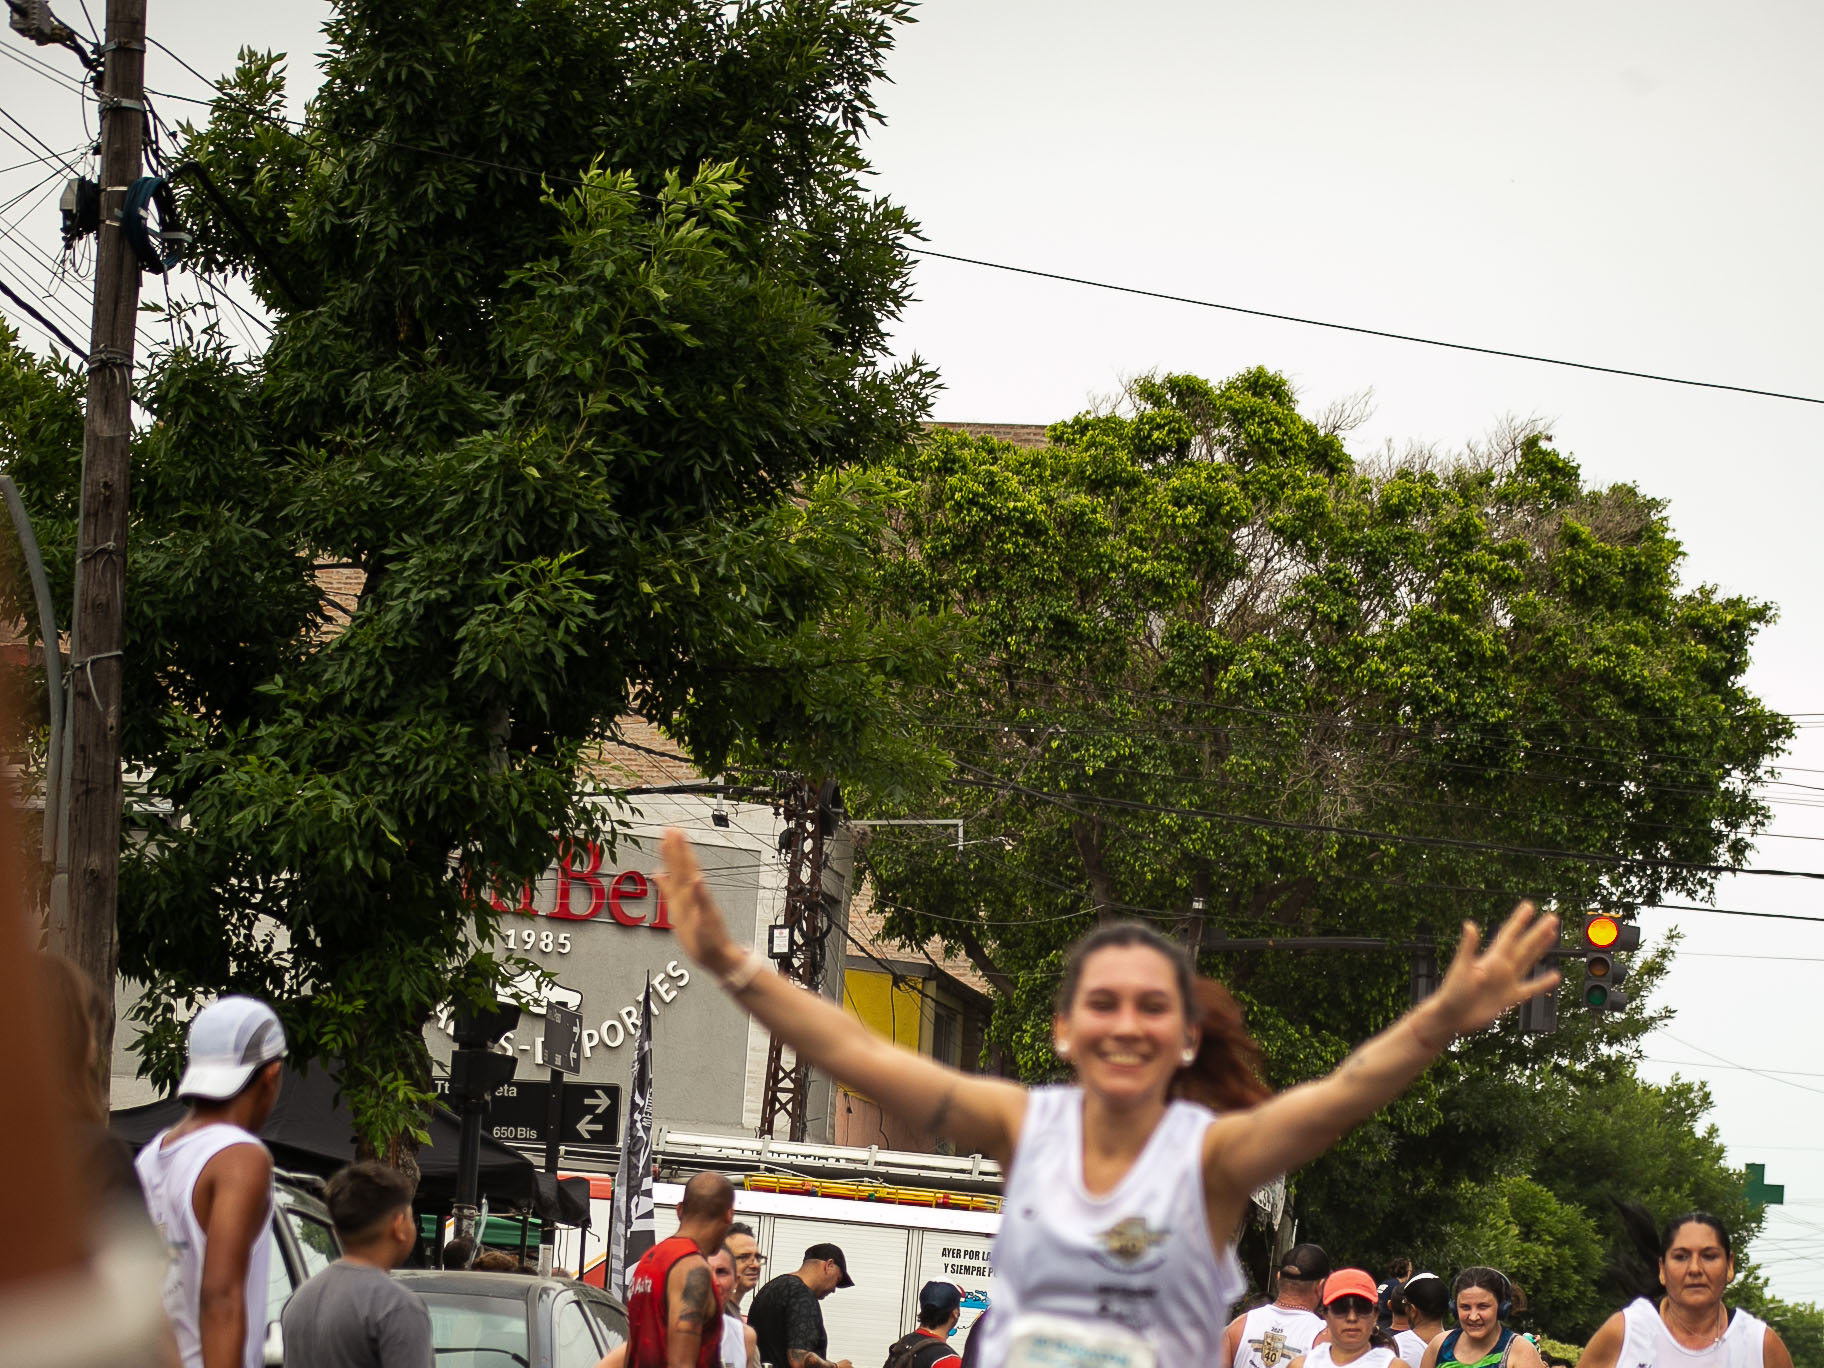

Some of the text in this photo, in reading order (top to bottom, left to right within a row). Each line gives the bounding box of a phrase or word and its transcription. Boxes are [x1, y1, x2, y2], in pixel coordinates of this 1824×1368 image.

[504, 928, 572, 954] 1985
[492, 1127, 537, 1140] 650 Bis
[941, 1247, 962, 1260] AYER
[963, 1249, 981, 1261] POR
[943, 1262, 950, 1274] Y
[950, 1263, 987, 1277] SIEMPRE
[1264, 1351, 1277, 1363] 40
